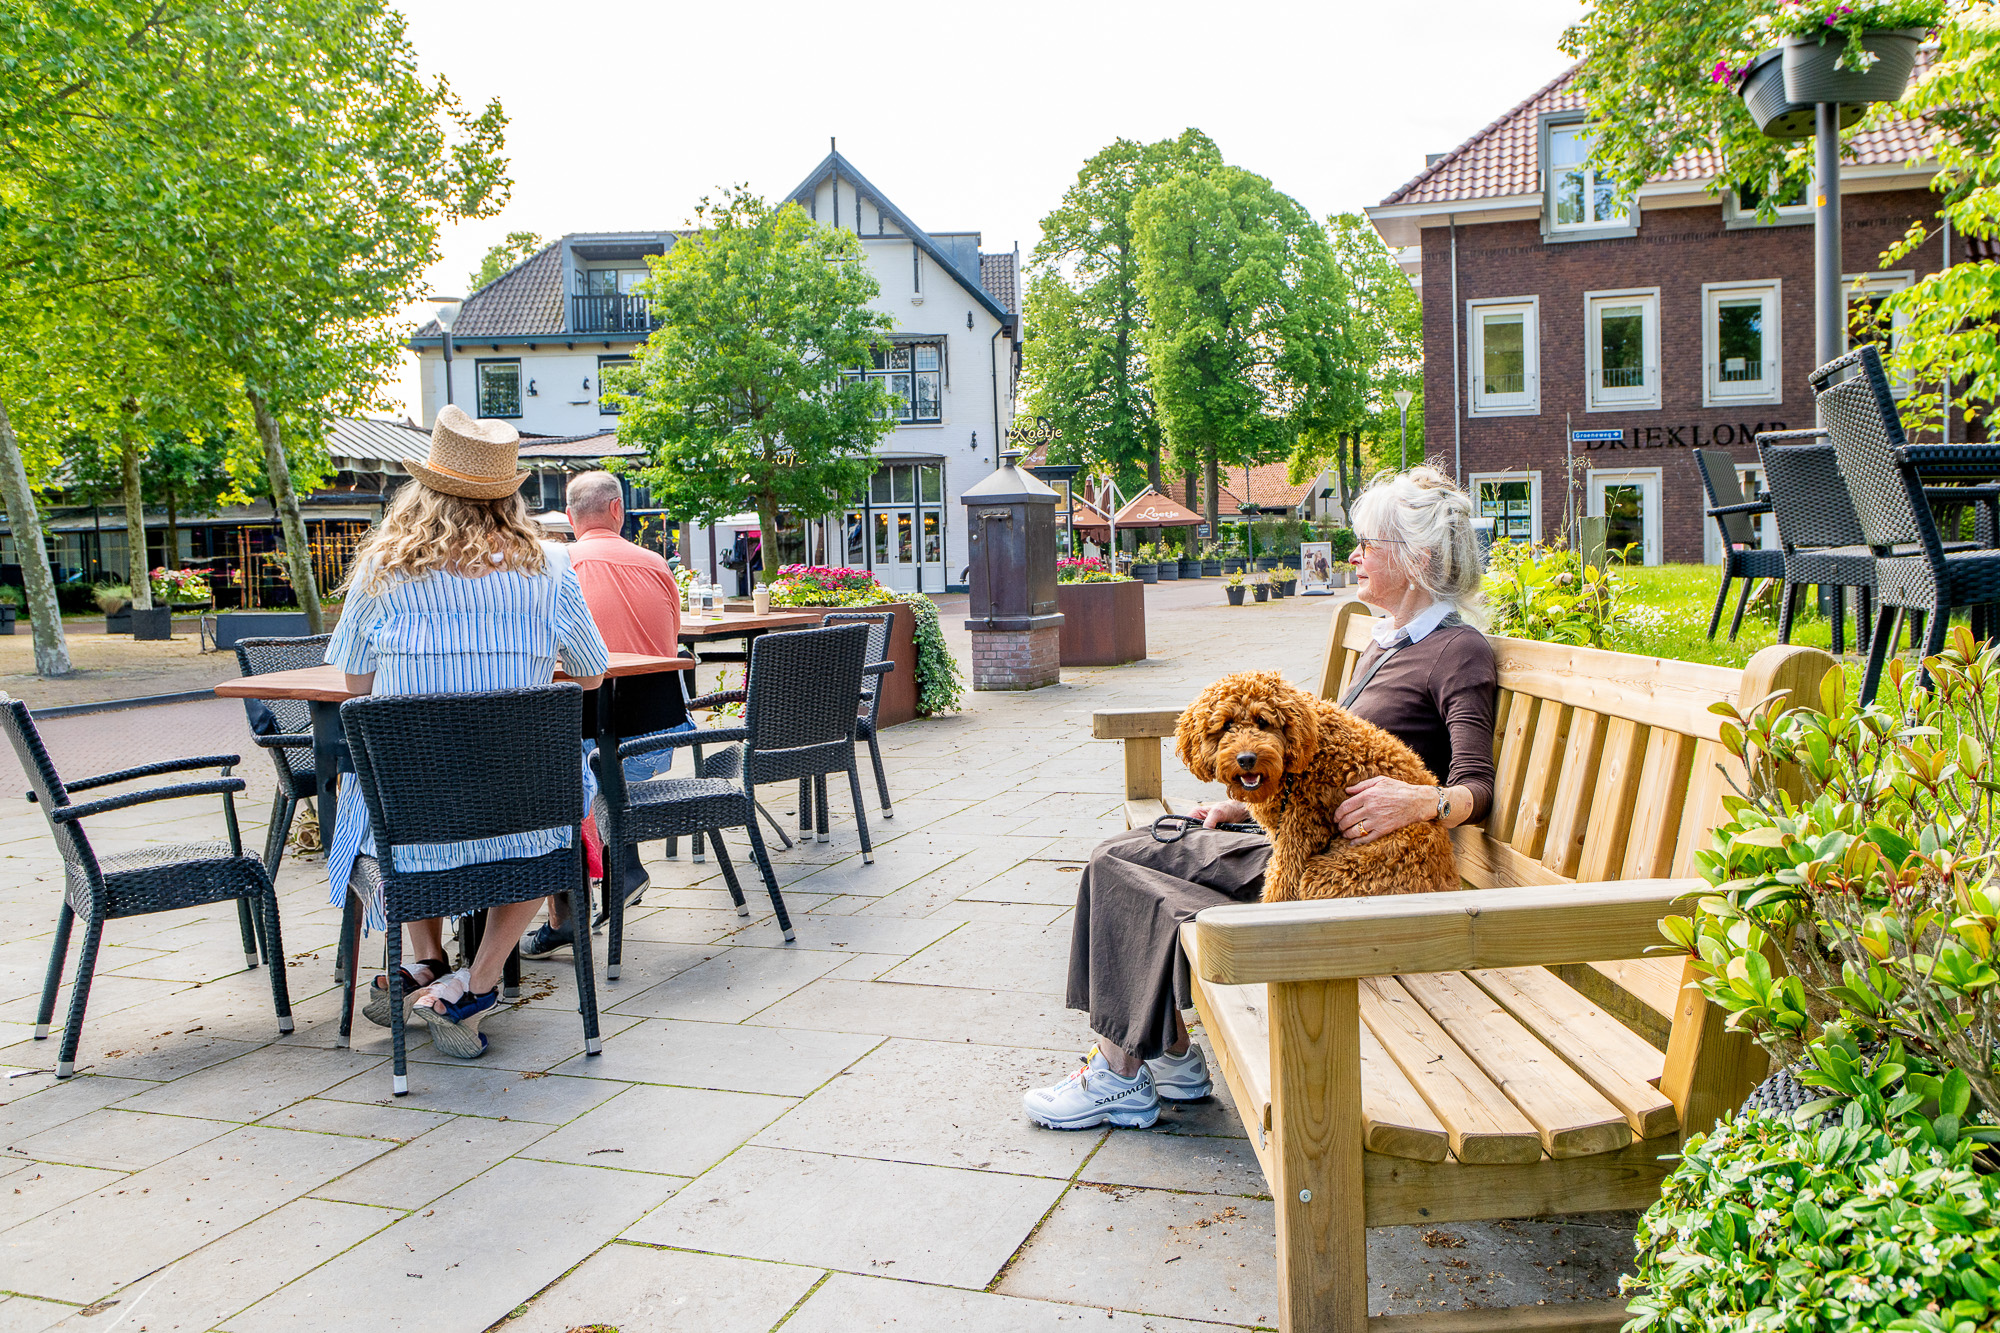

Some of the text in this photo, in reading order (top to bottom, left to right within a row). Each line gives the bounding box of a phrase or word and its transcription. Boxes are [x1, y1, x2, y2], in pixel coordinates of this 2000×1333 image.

[1009, 416, 1063, 446] Loetje
[1136, 506, 1180, 521] Loetje
[1095, 1079, 1151, 1107] SALOMON
